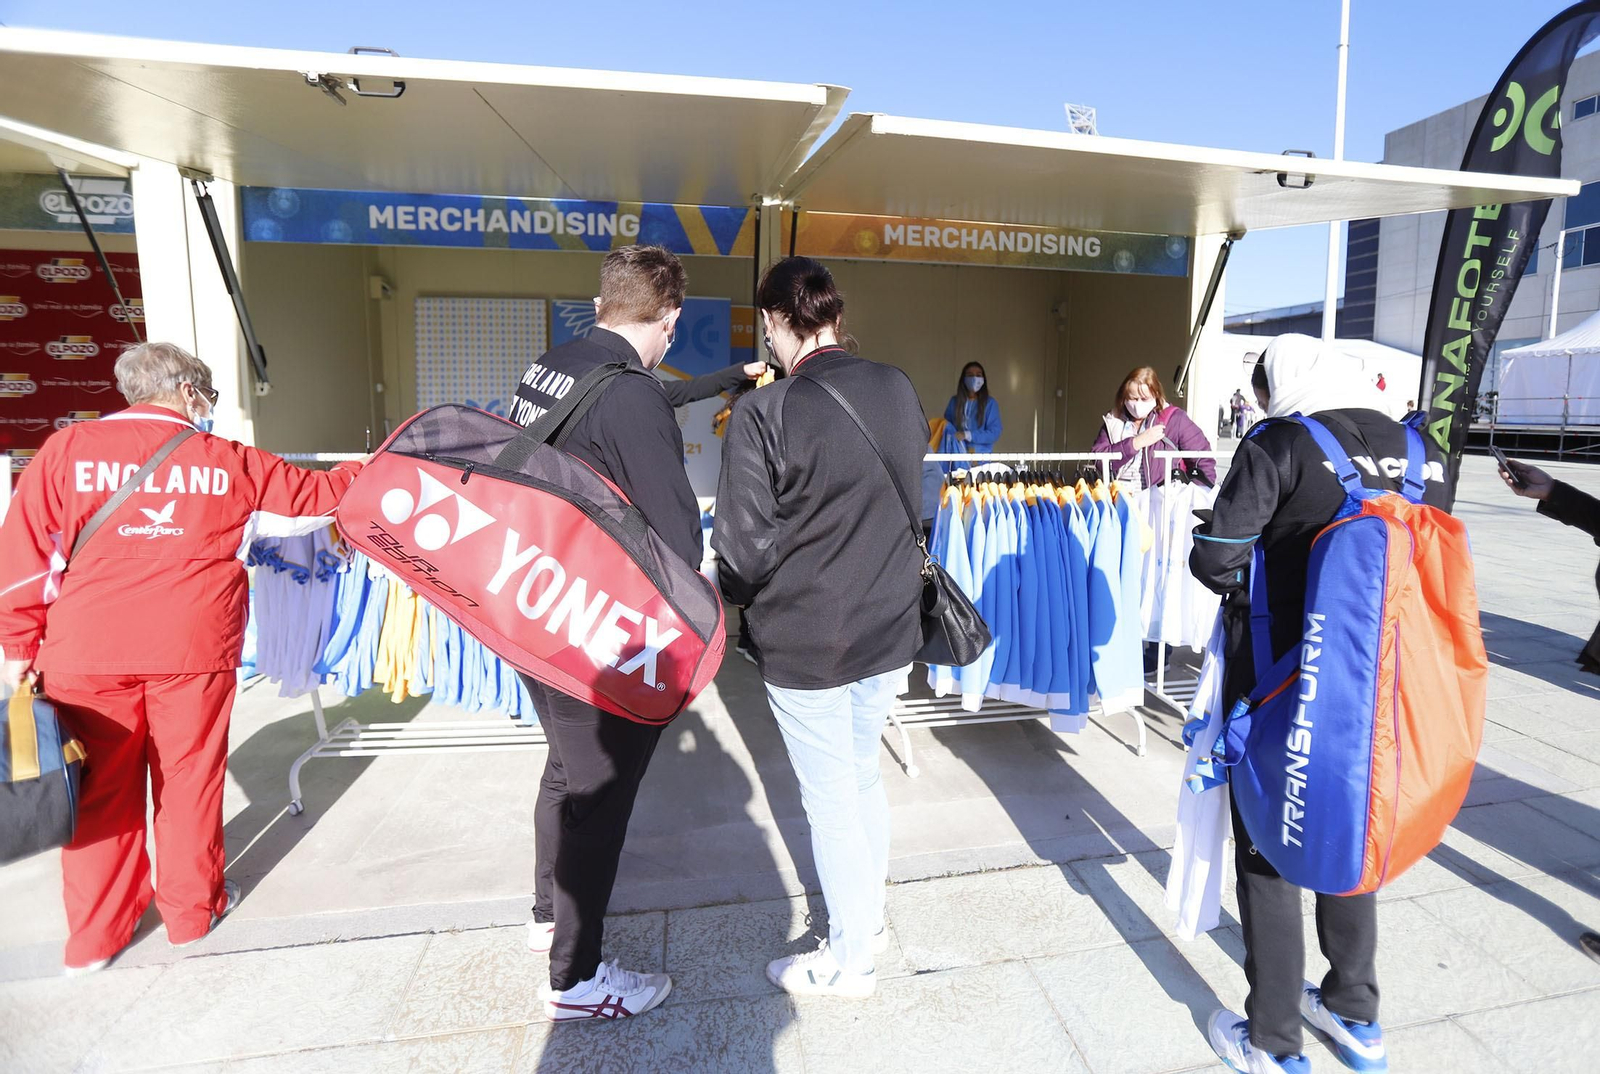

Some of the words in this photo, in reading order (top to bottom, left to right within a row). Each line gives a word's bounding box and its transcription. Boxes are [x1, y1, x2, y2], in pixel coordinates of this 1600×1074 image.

[368, 205, 640, 236] MERCHANDISING
[883, 224, 1101, 257] MERCHANDISING
[1471, 229, 1520, 332] YOURSELF
[369, 520, 440, 573] TOUR
[486, 527, 683, 688] YONEX
[1282, 612, 1326, 848] TRANSFORM
